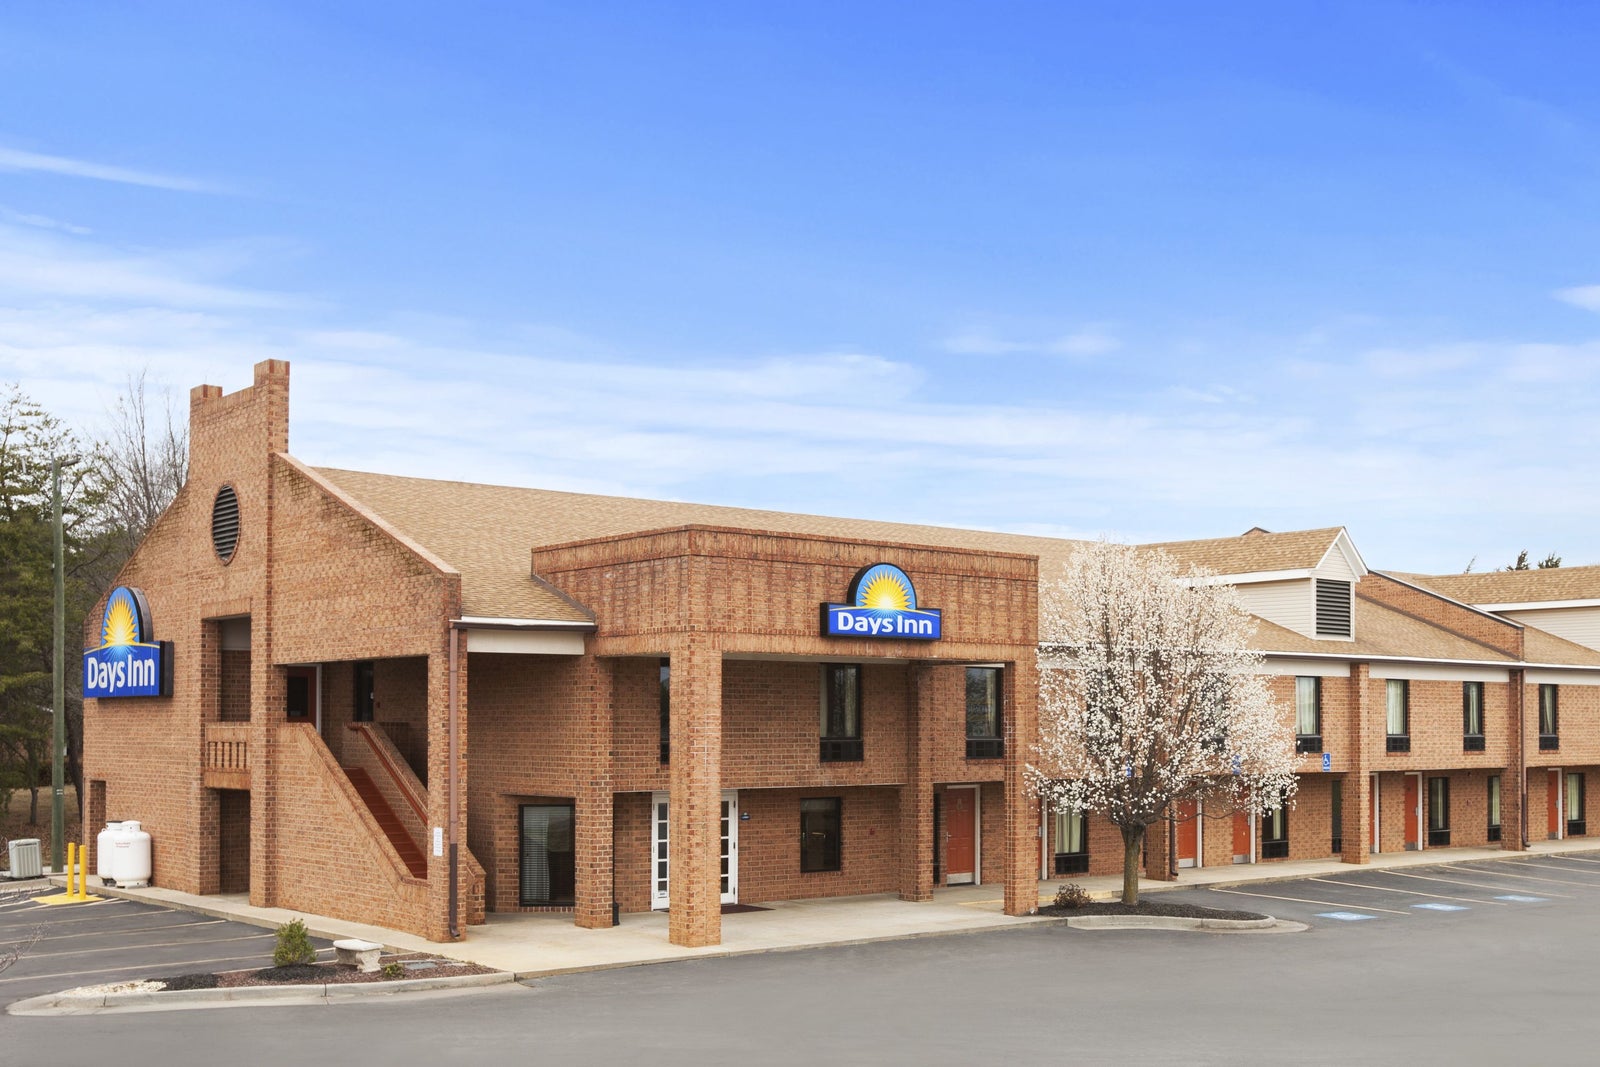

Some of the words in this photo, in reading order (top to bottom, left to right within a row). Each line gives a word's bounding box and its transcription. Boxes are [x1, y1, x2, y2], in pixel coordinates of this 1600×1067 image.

[838, 612, 894, 635] Days
[897, 615, 932, 634] Inn
[87, 657, 126, 693] Days
[127, 654, 155, 687] Inn
